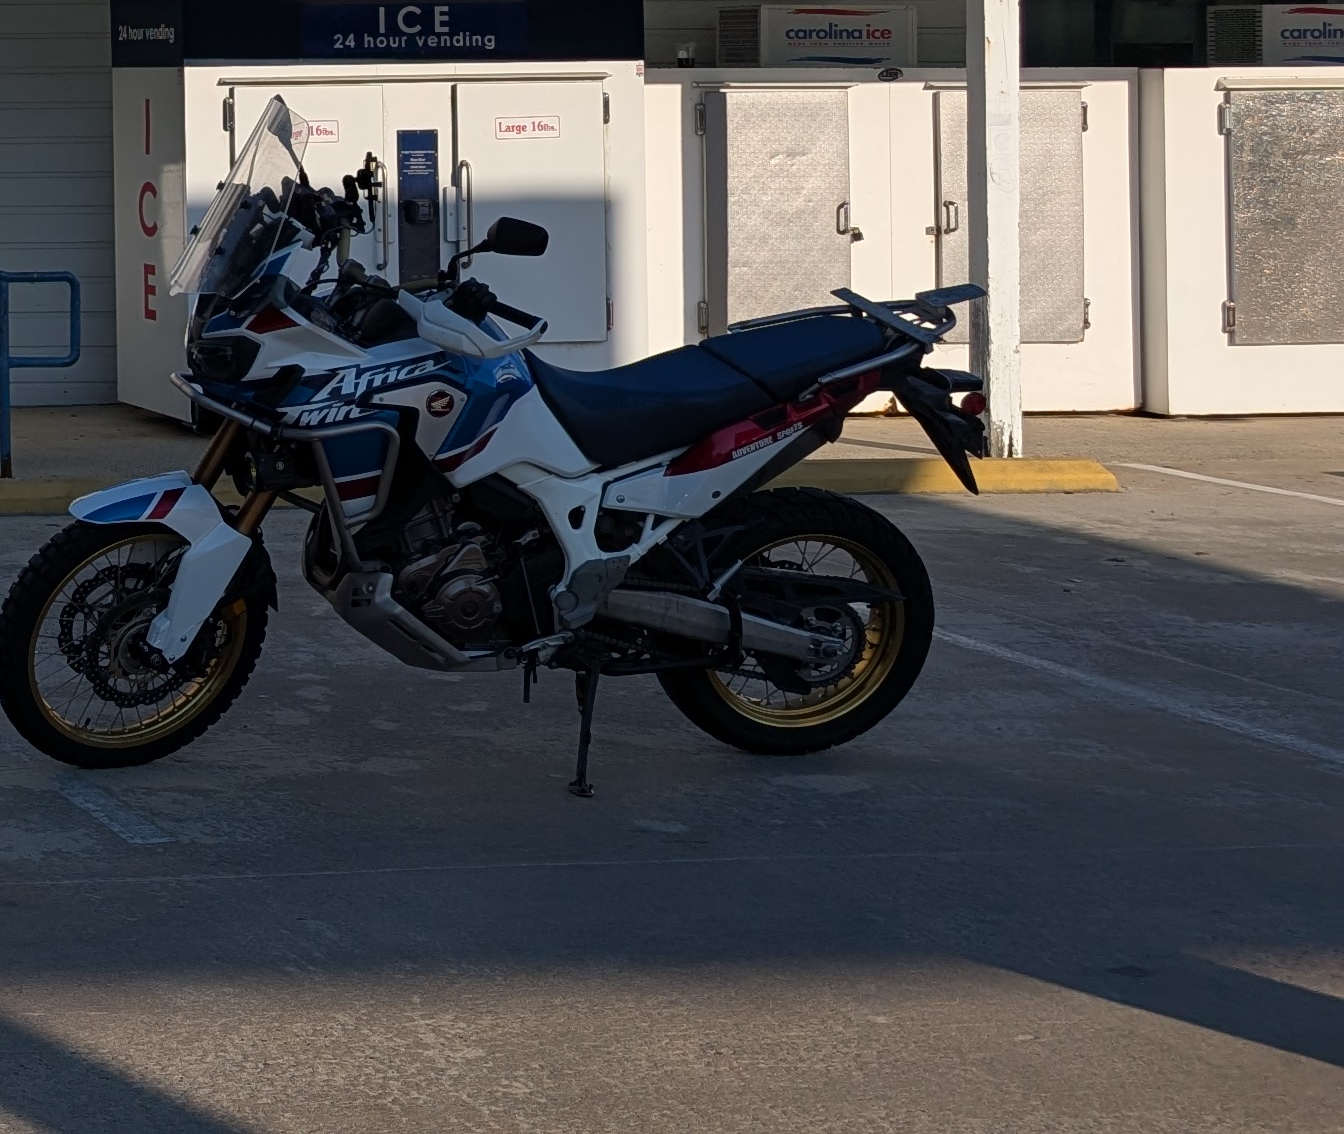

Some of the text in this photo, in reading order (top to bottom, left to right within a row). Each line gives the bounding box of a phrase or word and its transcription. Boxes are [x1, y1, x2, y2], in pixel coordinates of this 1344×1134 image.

[378, 5, 450, 34] ICE
[785, 22, 892, 40] carolina ice
[1281, 22, 1344, 40] carolin
[118, 23, 175, 44] 24 hour vending
[333, 31, 496, 50] 24 hour vending
[499, 122, 527, 134] Large
[138, 98, 158, 321] ICE
[310, 360, 452, 402] Africa
[276, 400, 378, 426] Twin
[732, 421, 803, 459] ADVENTURE SPORTS
